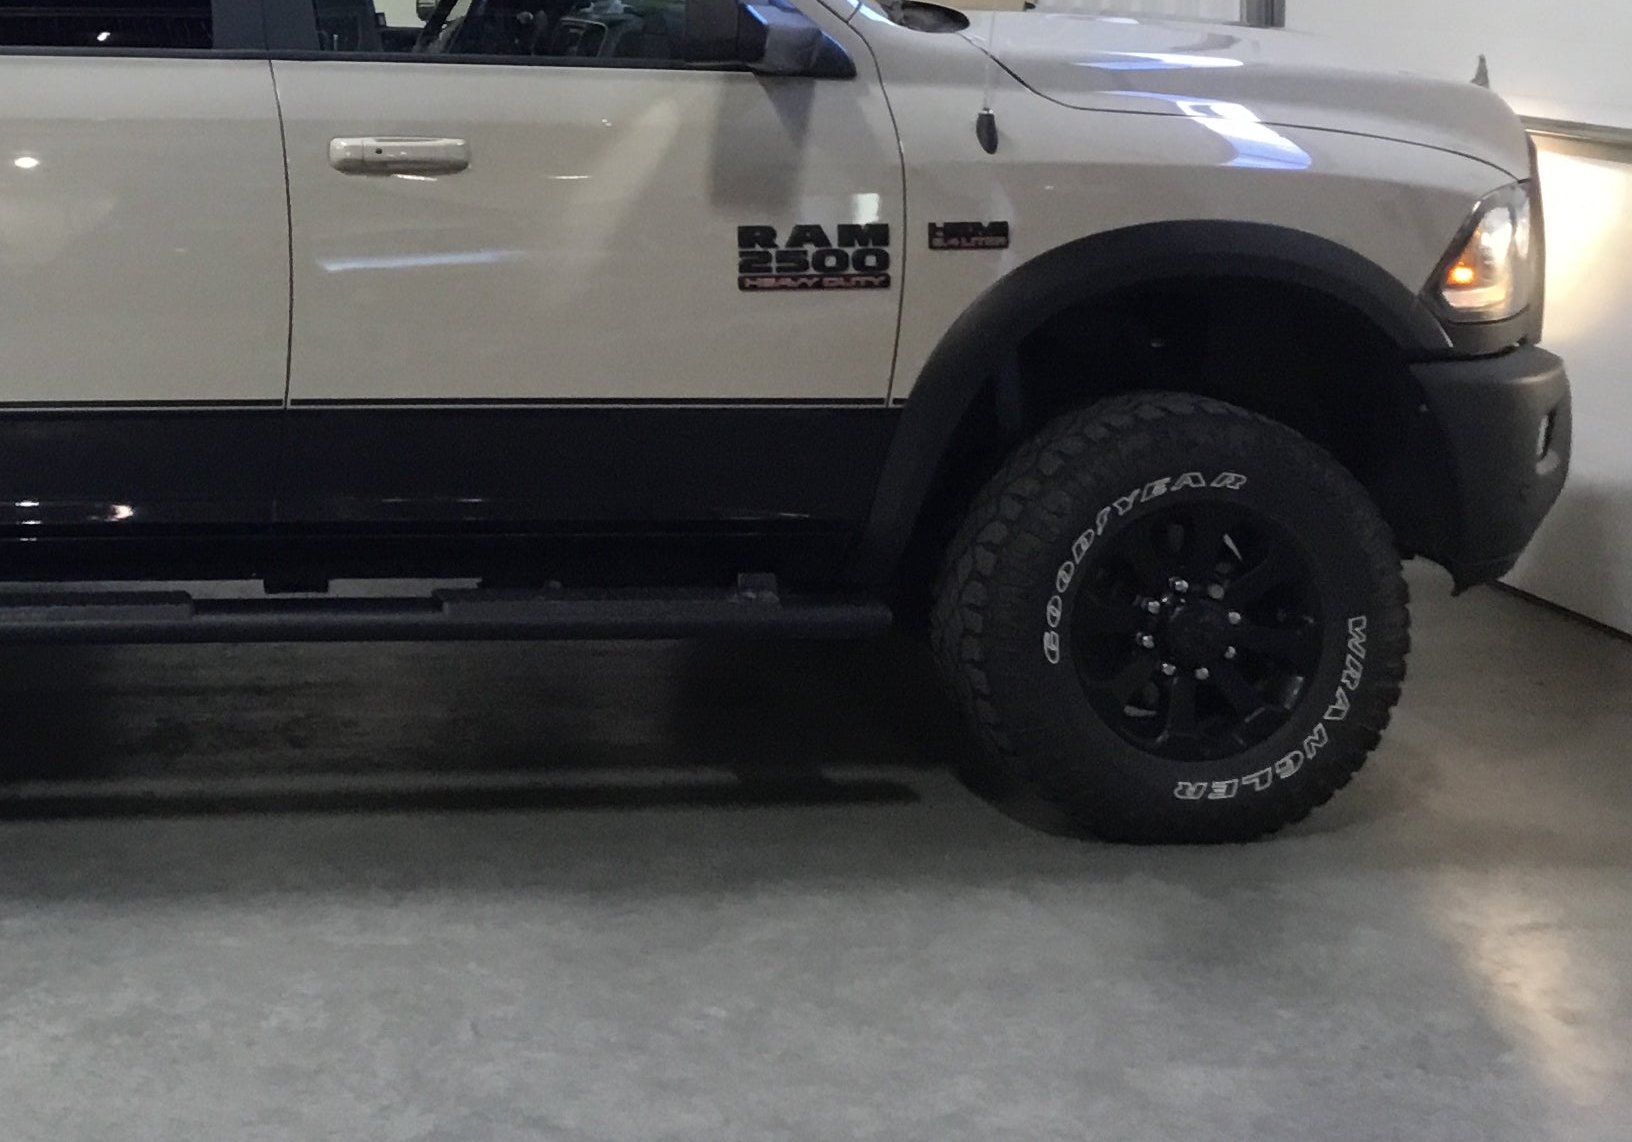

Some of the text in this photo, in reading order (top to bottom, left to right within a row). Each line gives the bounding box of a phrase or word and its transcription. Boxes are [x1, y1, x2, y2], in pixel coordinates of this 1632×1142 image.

[737, 223, 890, 248] RAM
[738, 248, 890, 273] 2500
[1044, 471, 1247, 664] GOODYEAR
[1173, 616, 1367, 800] WRANGLER
